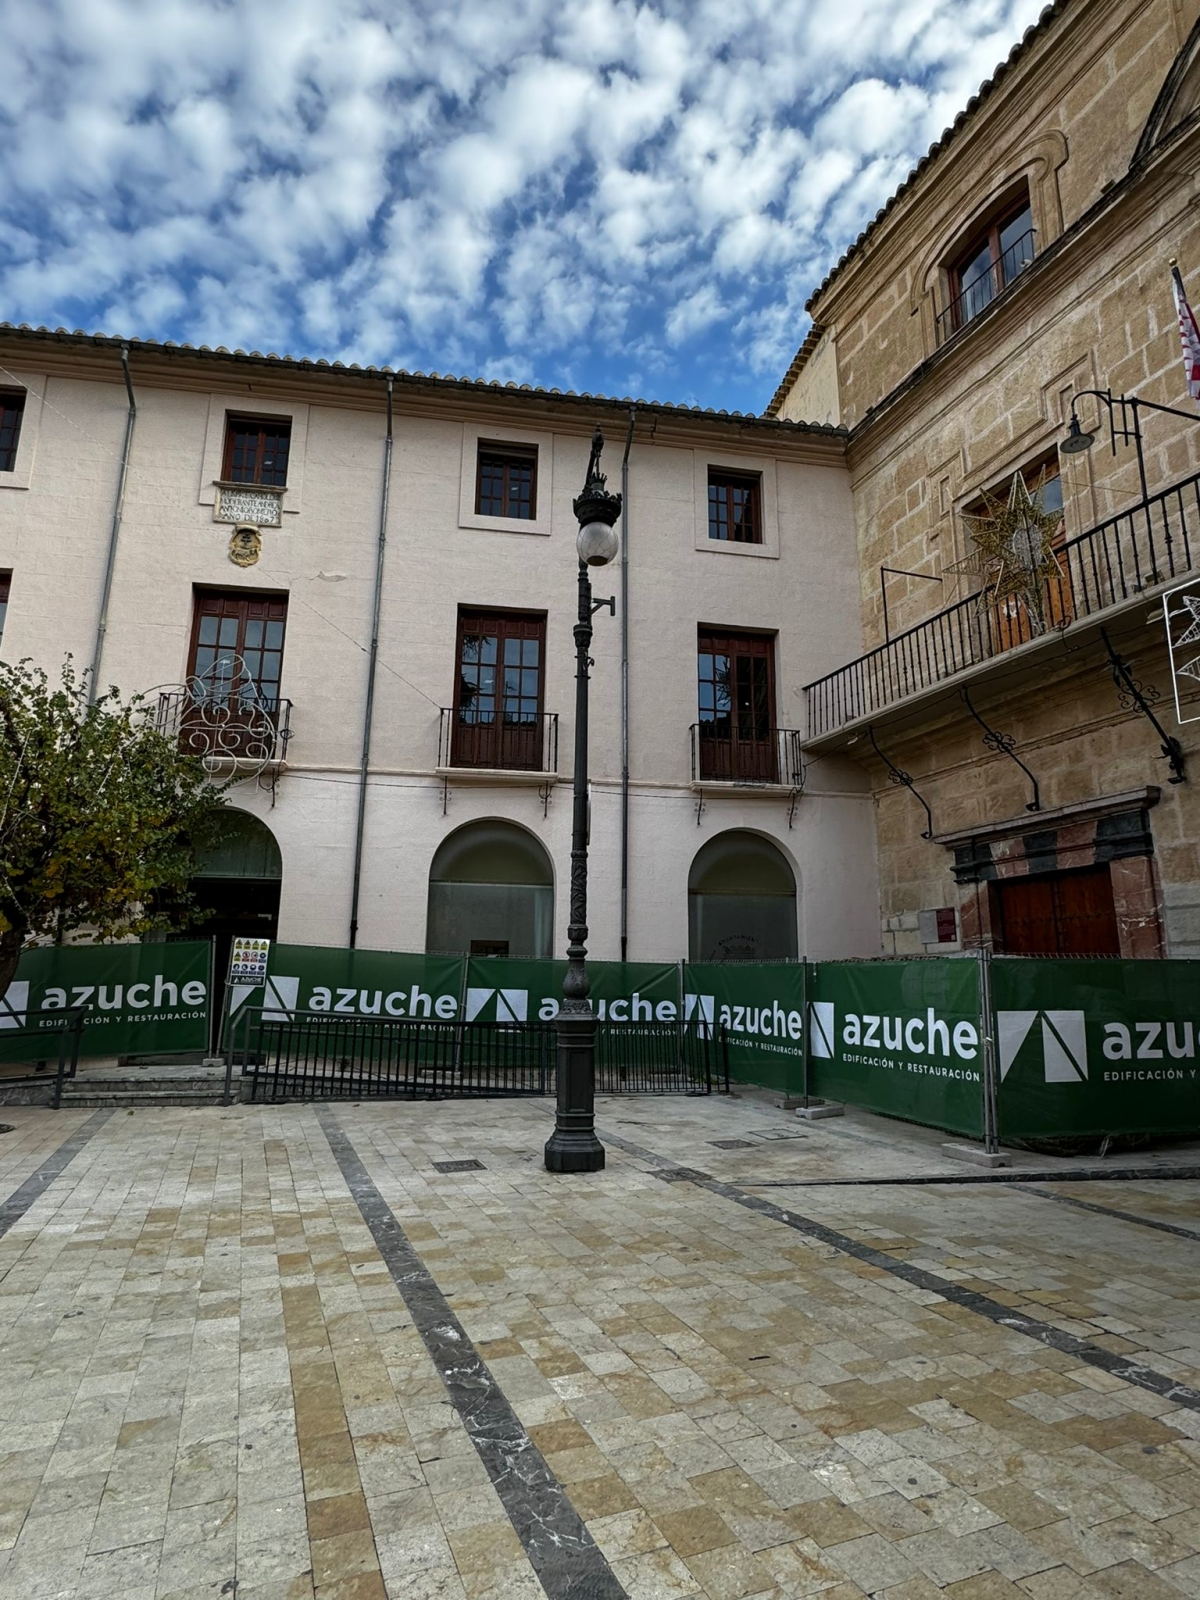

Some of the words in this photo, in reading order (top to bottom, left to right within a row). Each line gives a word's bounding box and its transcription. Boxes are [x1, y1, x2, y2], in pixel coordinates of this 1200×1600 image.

[41, 974, 207, 1010] azuche
[308, 985, 458, 1019] azuche
[538, 992, 677, 1021] auche
[38, 1016, 110, 1027] EDIFICIÓN
[115, 1015, 122, 1023] Y
[127, 1010, 207, 1022] RESTAURACIÓN
[719, 1000, 802, 1040] azuche
[842, 1007, 979, 1060] azuche
[754, 1041, 760, 1049] Y
[760, 1042, 803, 1057] RESTAURACIÓN
[1102, 1022, 1200, 1060] azu
[842, 1052, 894, 1069] EDIFICACIÓN
[898, 1062, 904, 1070] Y
[907, 1062, 980, 1082] RESTAURACIÓN
[1103, 1067, 1184, 1081] EDIFICACIÓN
[1189, 1069, 1196, 1079] Y
